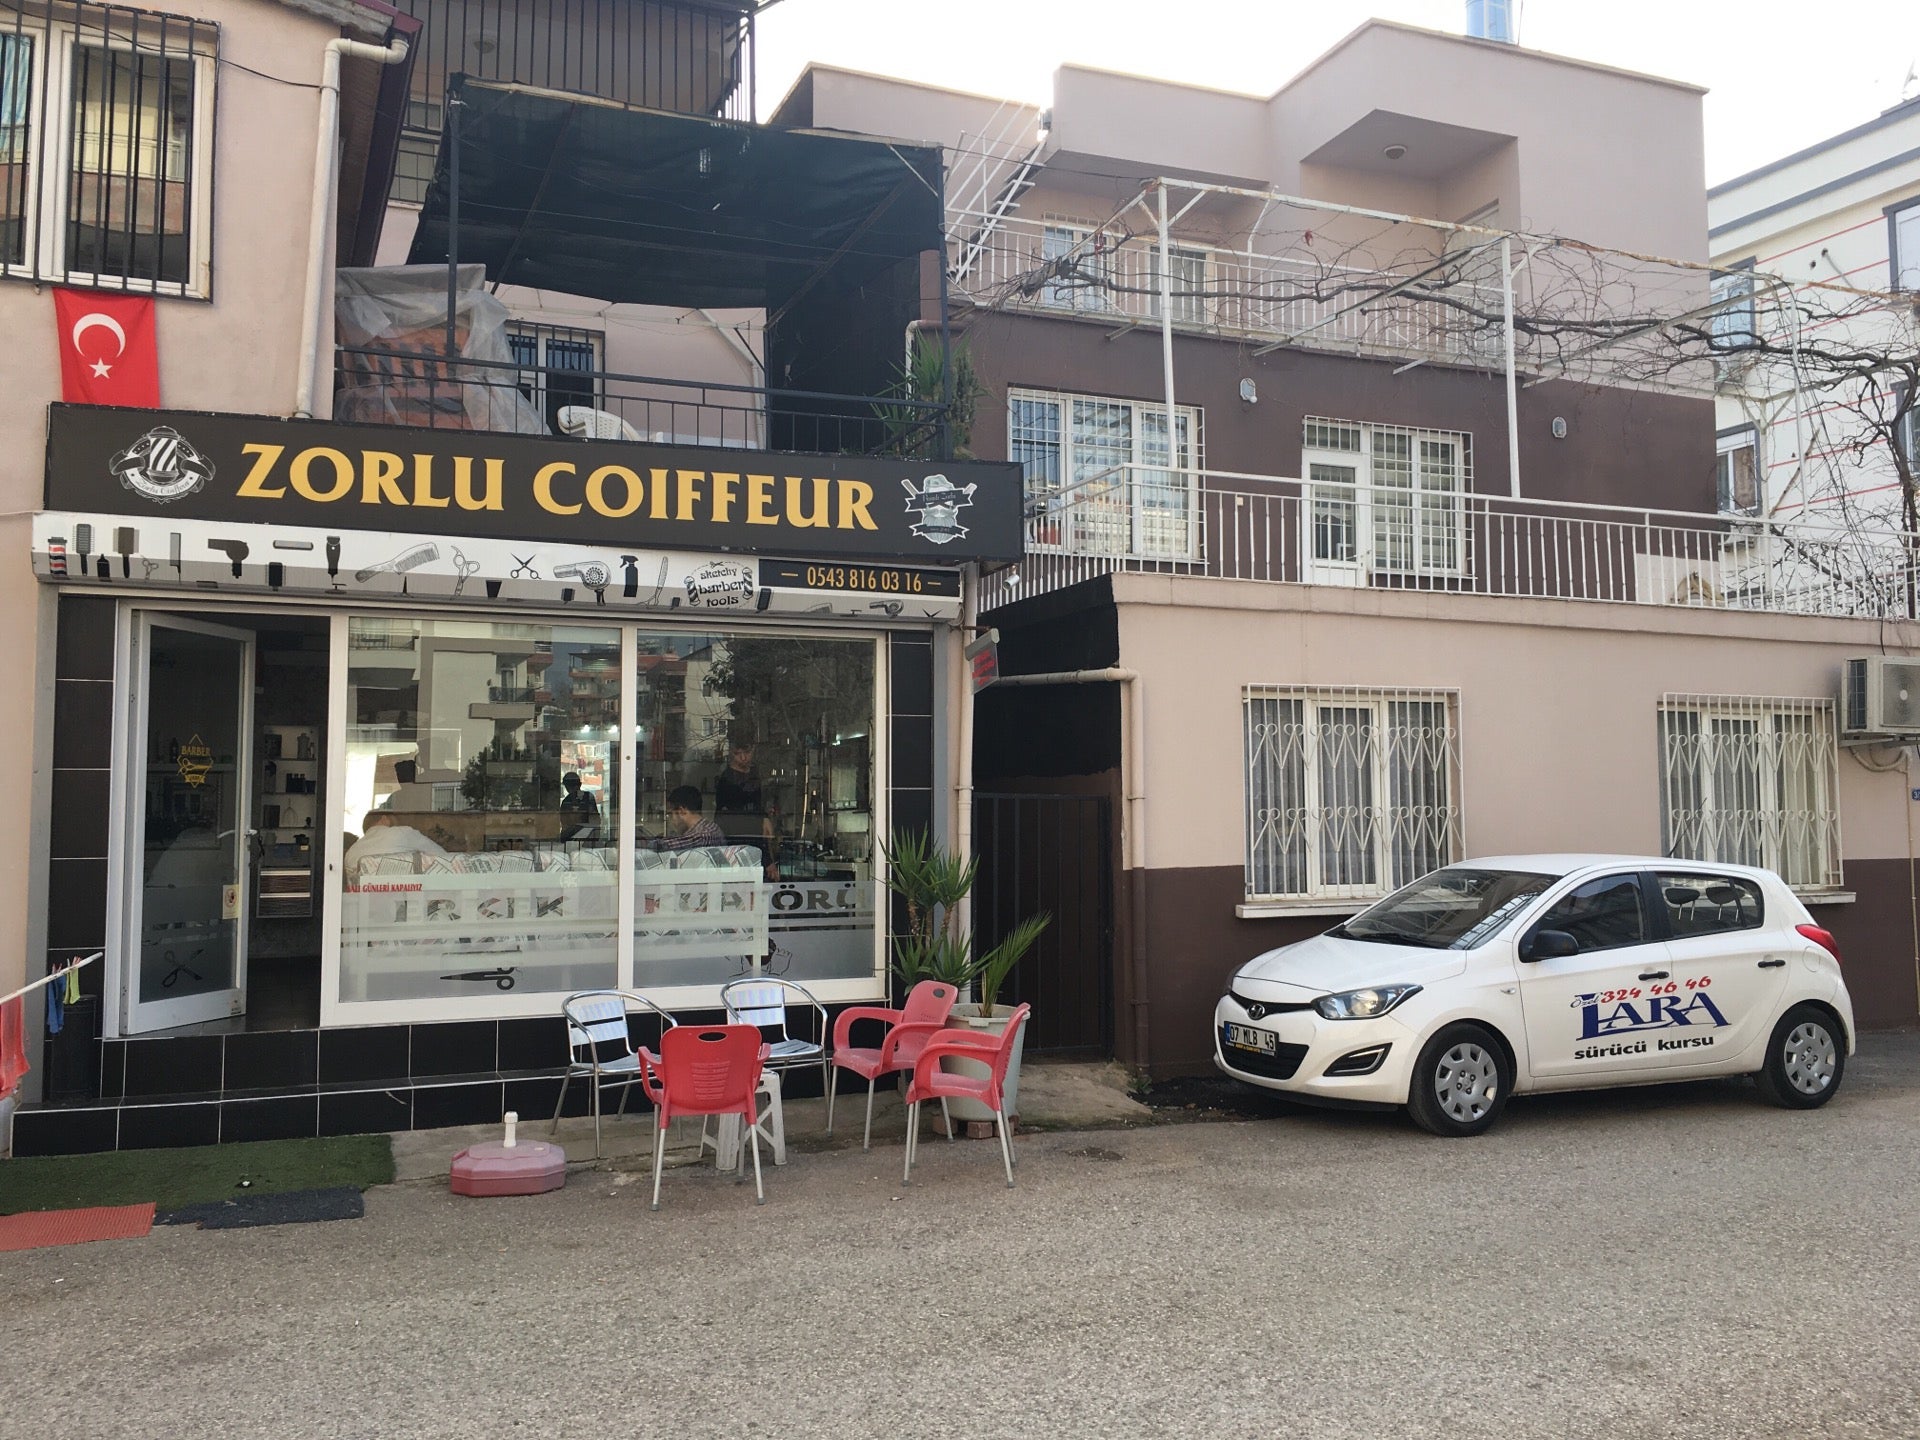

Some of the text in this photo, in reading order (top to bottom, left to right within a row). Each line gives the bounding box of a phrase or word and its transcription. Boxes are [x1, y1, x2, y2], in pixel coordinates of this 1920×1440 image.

[236, 443, 879, 531] ZORLU COIFFEUR
[700, 567, 737, 580] sketchy
[807, 566, 922, 592] 0543 816 03 16
[698, 580, 744, 594] barber
[706, 596, 739, 607] tools
[181, 745, 211, 757] BARBER
[362, 882, 390, 893] GÜNLERİ
[391, 883, 423, 892] KAPALIYIZ
[1601, 976, 1711, 1003] 324 46 46
[1575, 992, 1732, 1041] LARA
[1230, 1025, 1239, 1042] 07
[1265, 1034, 1274, 1050] 45
[1574, 1036, 1714, 1059] sürücü kursu
